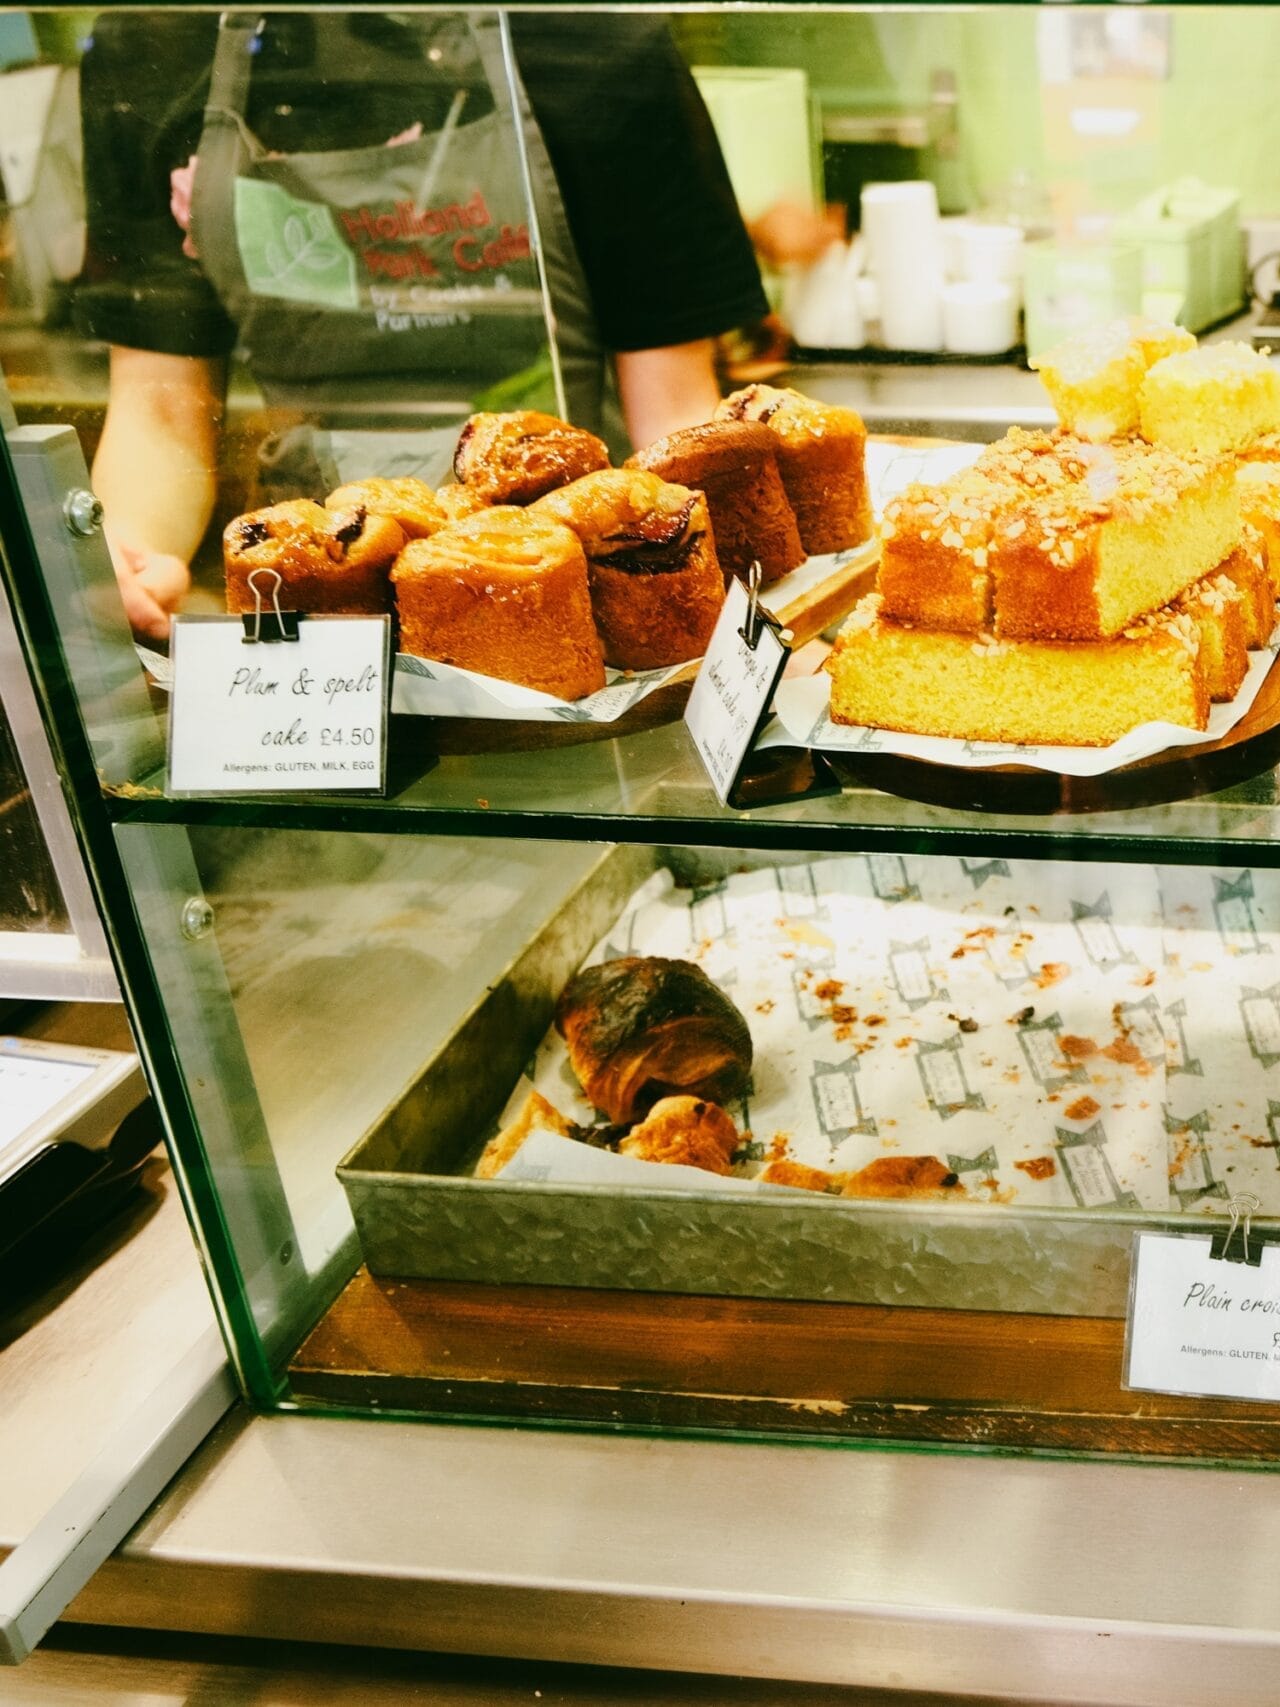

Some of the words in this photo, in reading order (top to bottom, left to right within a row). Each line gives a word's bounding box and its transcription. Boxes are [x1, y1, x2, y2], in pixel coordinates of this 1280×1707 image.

[342, 190, 490, 240] Holland
[228, 667, 279, 697] Plum
[291, 667, 314, 696] &
[323, 664, 379, 705] spelt
[261, 718, 309, 747] cake
[320, 727, 375, 746] £4.50
[222, 762, 271, 775] Allergens:
[274, 761, 319, 773] GLUTEN,
[321, 761, 348, 772] MILK,
[352, 760, 375, 771] EGG
[1183, 1281, 1231, 1312] Plain
[1180, 1344, 1227, 1358] Allergens:
[1228, 1349, 1270, 1361] GLUTEN,
